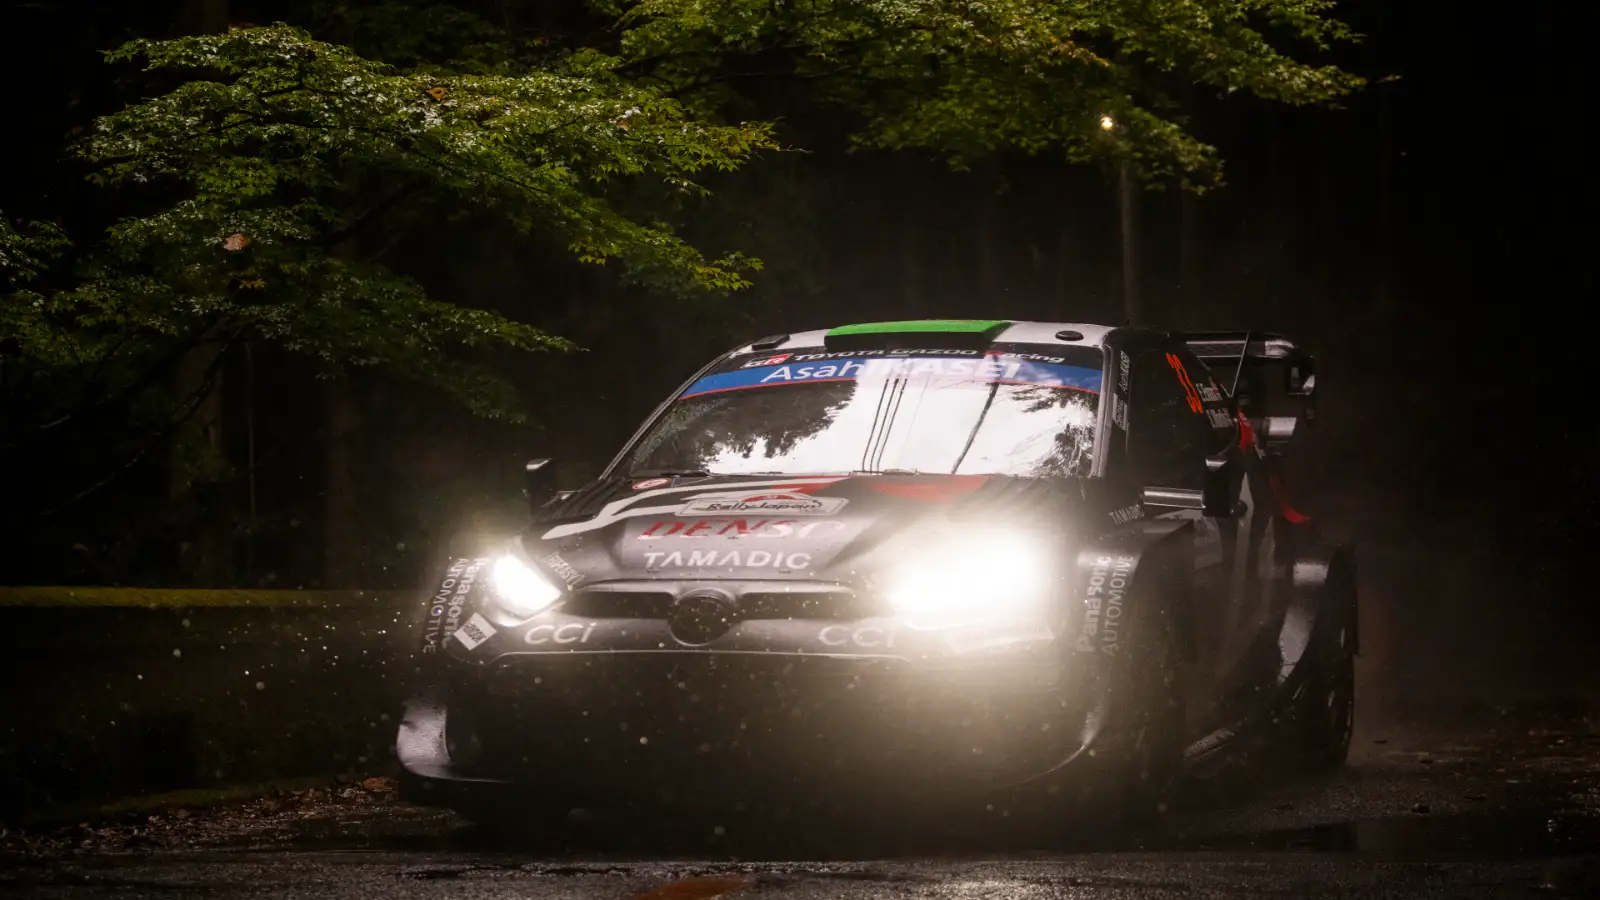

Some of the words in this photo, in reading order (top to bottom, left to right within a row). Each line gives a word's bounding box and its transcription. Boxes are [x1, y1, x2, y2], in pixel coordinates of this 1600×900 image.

[794, 350, 883, 361] TOYOTA
[888, 347, 978, 358] GAZOO
[423, 558, 469, 653] AUTOMOTIVE
[644, 551, 812, 569] TAMADIC
[1077, 556, 1112, 652] Panasonic
[1101, 556, 1134, 656] AUTOMOTIVE
